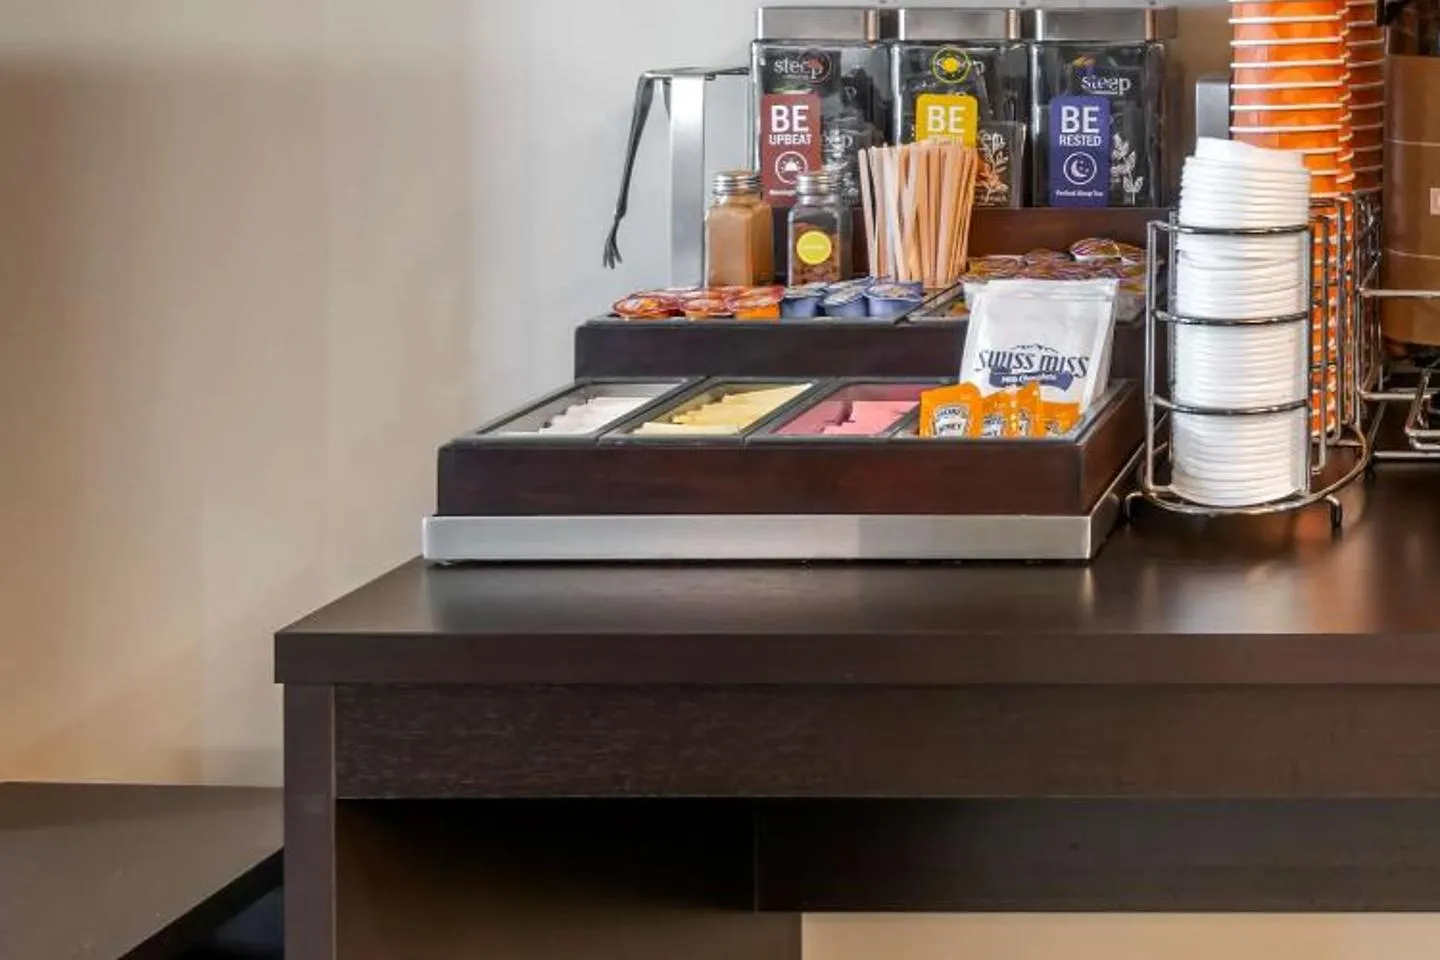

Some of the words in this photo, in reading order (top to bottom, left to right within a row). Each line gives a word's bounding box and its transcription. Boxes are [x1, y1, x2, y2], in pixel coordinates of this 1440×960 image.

[1080, 74, 1132, 96] steep
[770, 104, 810, 133] BE
[926, 104, 967, 134] BE
[1060, 105, 1100, 134] BE
[768, 133, 813, 146] UPBEAT
[1058, 134, 1102, 147] RESTED
